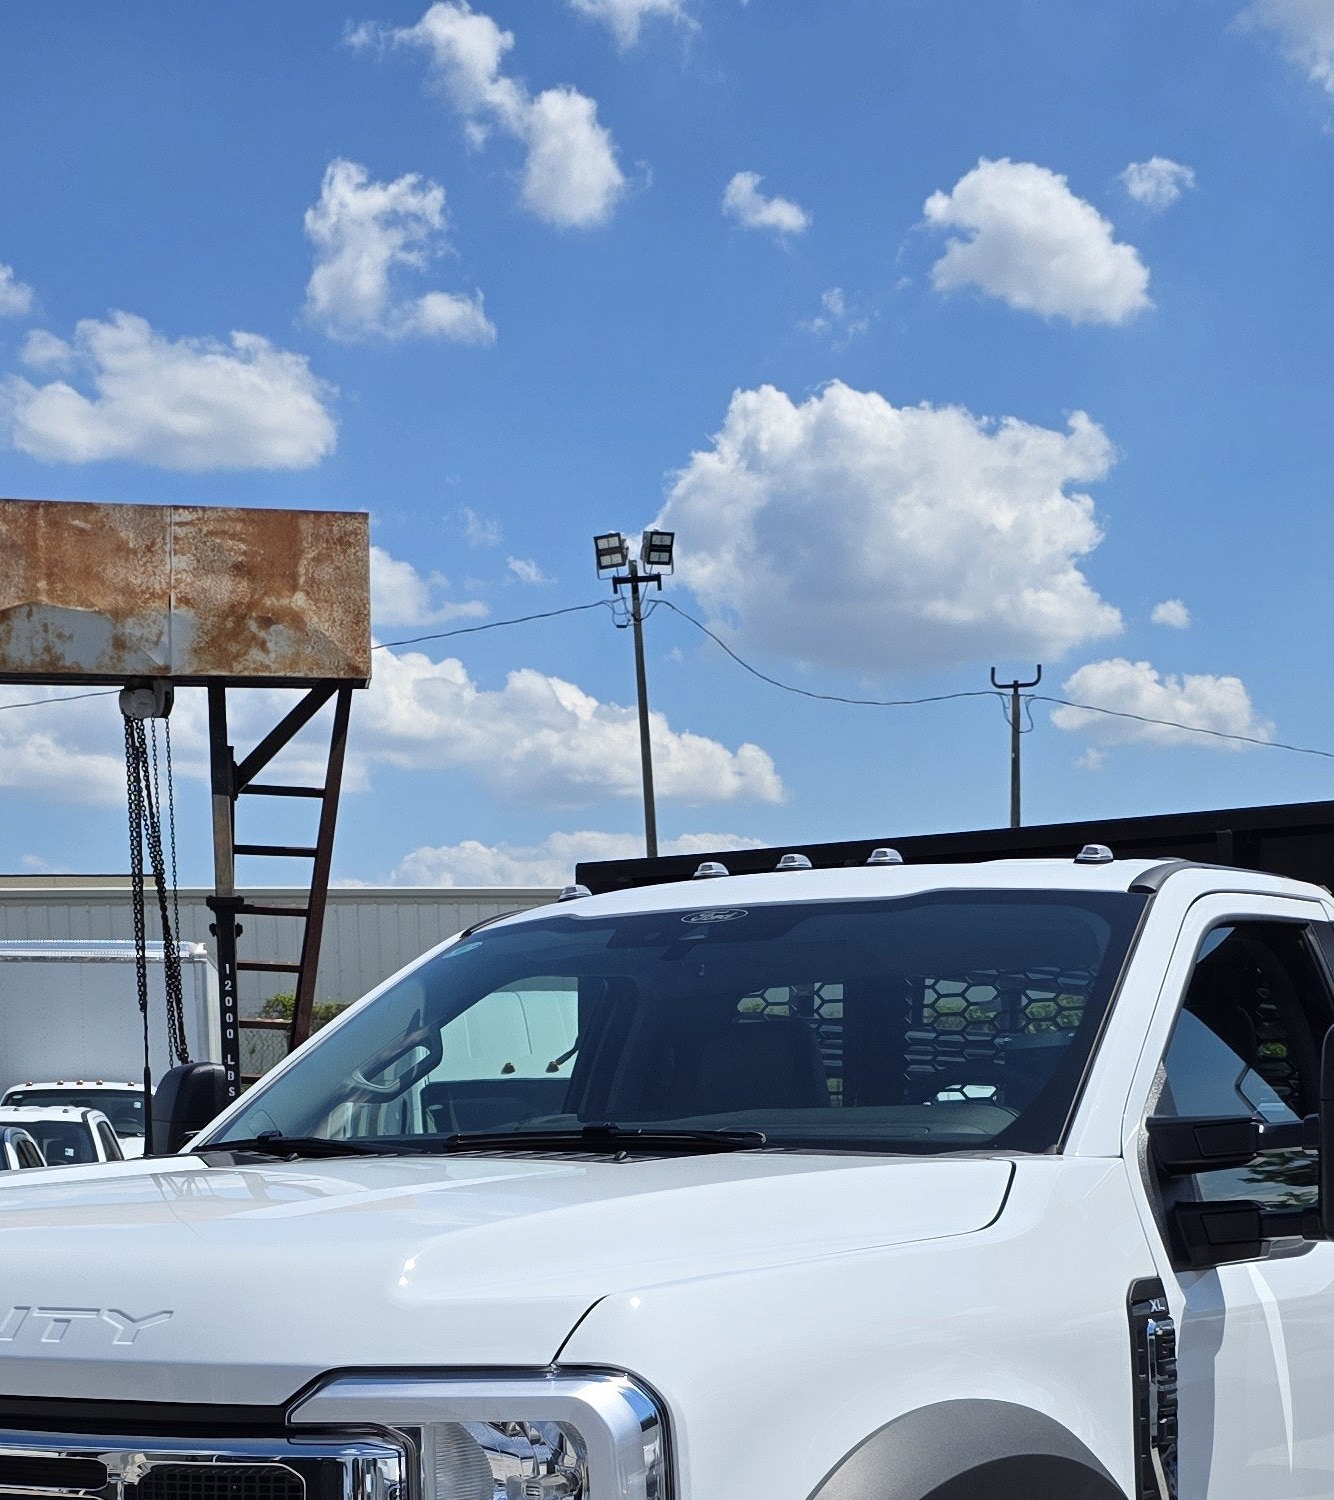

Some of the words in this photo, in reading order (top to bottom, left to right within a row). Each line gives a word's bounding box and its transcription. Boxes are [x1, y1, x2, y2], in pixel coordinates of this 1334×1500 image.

[224, 963, 234, 1039] 12000
[227, 1053, 236, 1097] LBS
[1148, 1299, 1166, 1312] XL
